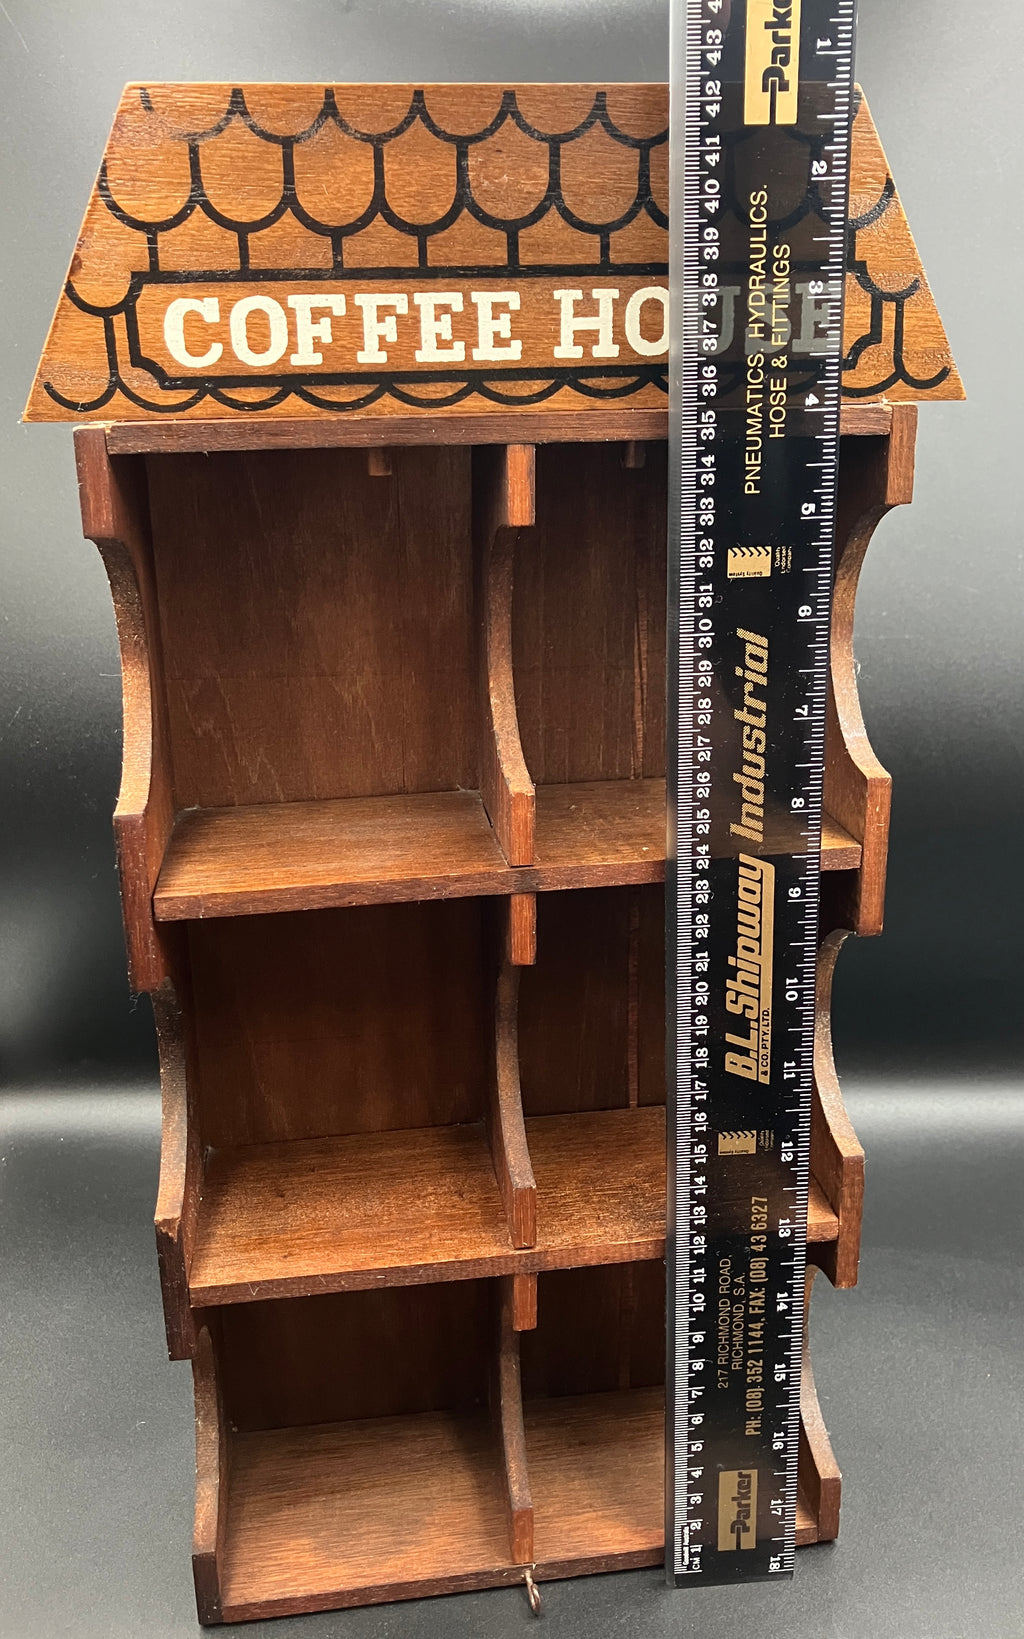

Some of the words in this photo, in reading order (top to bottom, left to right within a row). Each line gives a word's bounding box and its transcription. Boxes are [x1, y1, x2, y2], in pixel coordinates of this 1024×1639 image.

[817, 38, 832, 48] 1
[812, 160, 827, 174] 2
[748, 184, 768, 338] HYDRAULICS.
[772, 244, 791, 345] FITTINGS
[809, 280, 823, 294] 3
[162, 288, 522, 367] COFFEE
[772, 354, 788, 368] &
[769, 377, 787, 438] HOSE
[805, 393, 819, 406] 4
[745, 348, 765, 494] PNEUMATICS.
[801, 503, 815, 515] 5
[798, 606, 812, 617] 6
[795, 705, 808, 716] 7
[729, 627, 769, 843] Industrial
[791, 798, 804, 808] 8
[789, 887, 801, 898] 9
[762, 1007, 770, 1028] LTD.
[761, 1029, 769, 1050] PTY.
[761, 1052, 769, 1067] CO.
[751, 1197, 768, 1231] 6327
[751, 1235, 767, 1252] 43
[719, 1255, 732, 1294] ROAD,
[750, 1258, 769, 1282] (08)
[734, 1273, 745, 1295] S.A.
[749, 1288, 765, 1314] FAX:
[692, 1335, 704, 1343] 9
[718, 1298, 730, 1364] RICHMOND
[732, 1301, 746, 1370] RICHMOND,
[692, 1362, 704, 1371] 8
[747, 1360, 763, 1382] 352
[718, 1369, 728, 1388] 217
[692, 1390, 703, 1398] 7
[691, 1416, 703, 1424] 6
[691, 1444, 702, 1452] 5
[691, 1470, 702, 1478] 4
[690, 1496, 702, 1504] 3
[730, 1472, 753, 1534] Parker
[690, 1522, 701, 1530] 2
